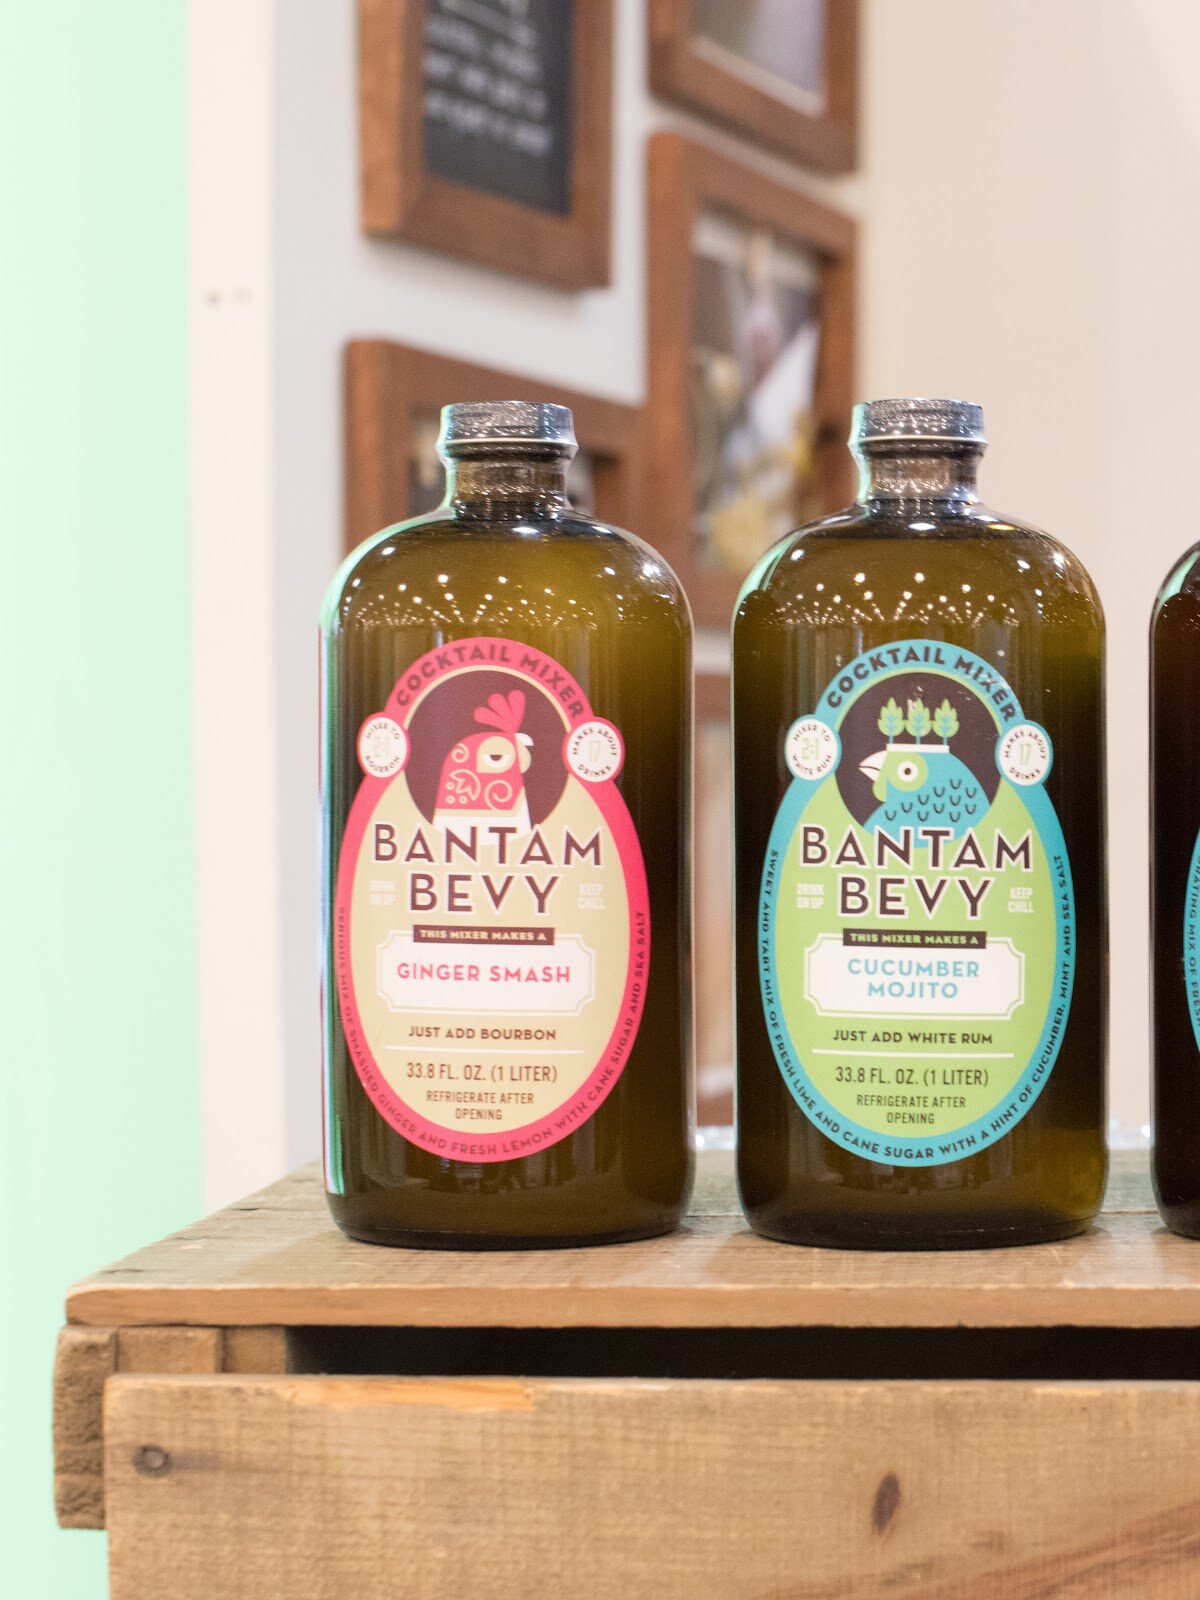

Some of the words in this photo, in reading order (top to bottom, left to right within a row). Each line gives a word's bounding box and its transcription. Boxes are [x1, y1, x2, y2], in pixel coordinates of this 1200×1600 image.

[397, 644, 512, 707] COCKTAIL
[519, 654, 584, 718] MIXER
[826, 645, 945, 709] COCKTAIL
[953, 656, 1016, 722] MIXER
[374, 823, 602, 866] BANTAM
[802, 826, 1030, 870] BANTAM
[765, 849, 778, 898] SWEET
[1053, 855, 1067, 888] SALT
[410, 873, 560, 914] BEVY
[841, 876, 990, 917] BEVY
[762, 901, 770, 933] AND
[1061, 893, 1070, 920] SEA
[419, 929, 447, 939] THIS
[450, 930, 489, 940] MIXER
[491, 931, 535, 941] MAKES
[537, 932, 547, 941] A
[850, 933, 878, 943] THIS
[881, 934, 921, 944] MIXER
[925, 935, 968, 945] MAKES
[970, 935, 979, 945] A
[1063, 925, 1071, 956] AND
[1188, 924, 1196, 950] MIX
[762, 938, 770, 974] TART
[847, 958, 979, 977] CUCUMBER
[1189, 957, 1197, 976] OF
[397, 962, 480, 982] GINGER
[489, 965, 571, 983] SMASH
[1060, 961, 1070, 999] MINT
[764, 979, 774, 1006] MIX
[867, 980, 958, 999] MOJITO
[769, 1010, 779, 1029] OF
[408, 1025, 441, 1038] JUST
[445, 1027, 475, 1039] ADD
[480, 1028, 557, 1040] BOURBON
[832, 1029, 867, 1042] JUST
[871, 1031, 903, 1043] ADD
[907, 1032, 957, 1044] WHITE
[961, 1033, 993, 1044] RUM
[1032, 1004, 1066, 1083] CUCUMBER,
[775, 1033, 796, 1078] FRESH
[406, 1062, 435, 1079] 33.8
[439, 1063, 459, 1080] FL.
[463, 1064, 486, 1081] OZ.
[491, 1065, 504, 1083] (1
[510, 1065, 558, 1083] LITER)
[835, 1066, 866, 1083] 33.8
[870, 1067, 891, 1084] FL.
[895, 1069, 919, 1085] OZ.
[923, 1068, 936, 1087] (1
[942, 1069, 989, 1087] LITER)
[349, 1029, 378, 1092] SMASHED
[378, 1093, 417, 1133] GINGER
[418, 1131, 447, 1149] AND
[451, 1142, 497, 1155] FRESH
[503, 1127, 553, 1153] LEMON
[555, 1102, 588, 1129] WITH
[587, 1067, 613, 1101] CANE
[611, 1017, 635, 1064] SUGAR
[426, 1090, 496, 1104] REFRIGERATE
[499, 1092, 534, 1105] AFTER
[793, 1078, 817, 1111] LIME
[1019, 1084, 1033, 1103] OF
[856, 1094, 929, 1108] REFRIGERATE
[932, 1096, 966, 1108] AFTER
[455, 1108, 502, 1120] OPENING
[815, 1110, 841, 1134] AND
[886, 1112, 935, 1125] OPENING
[990, 1102, 1021, 1132] HINT
[842, 1130, 880, 1154] CANE
[938, 1135, 977, 1155] WITH
[980, 1129, 990, 1141] A
[884, 1145, 934, 1159] SUGAR
